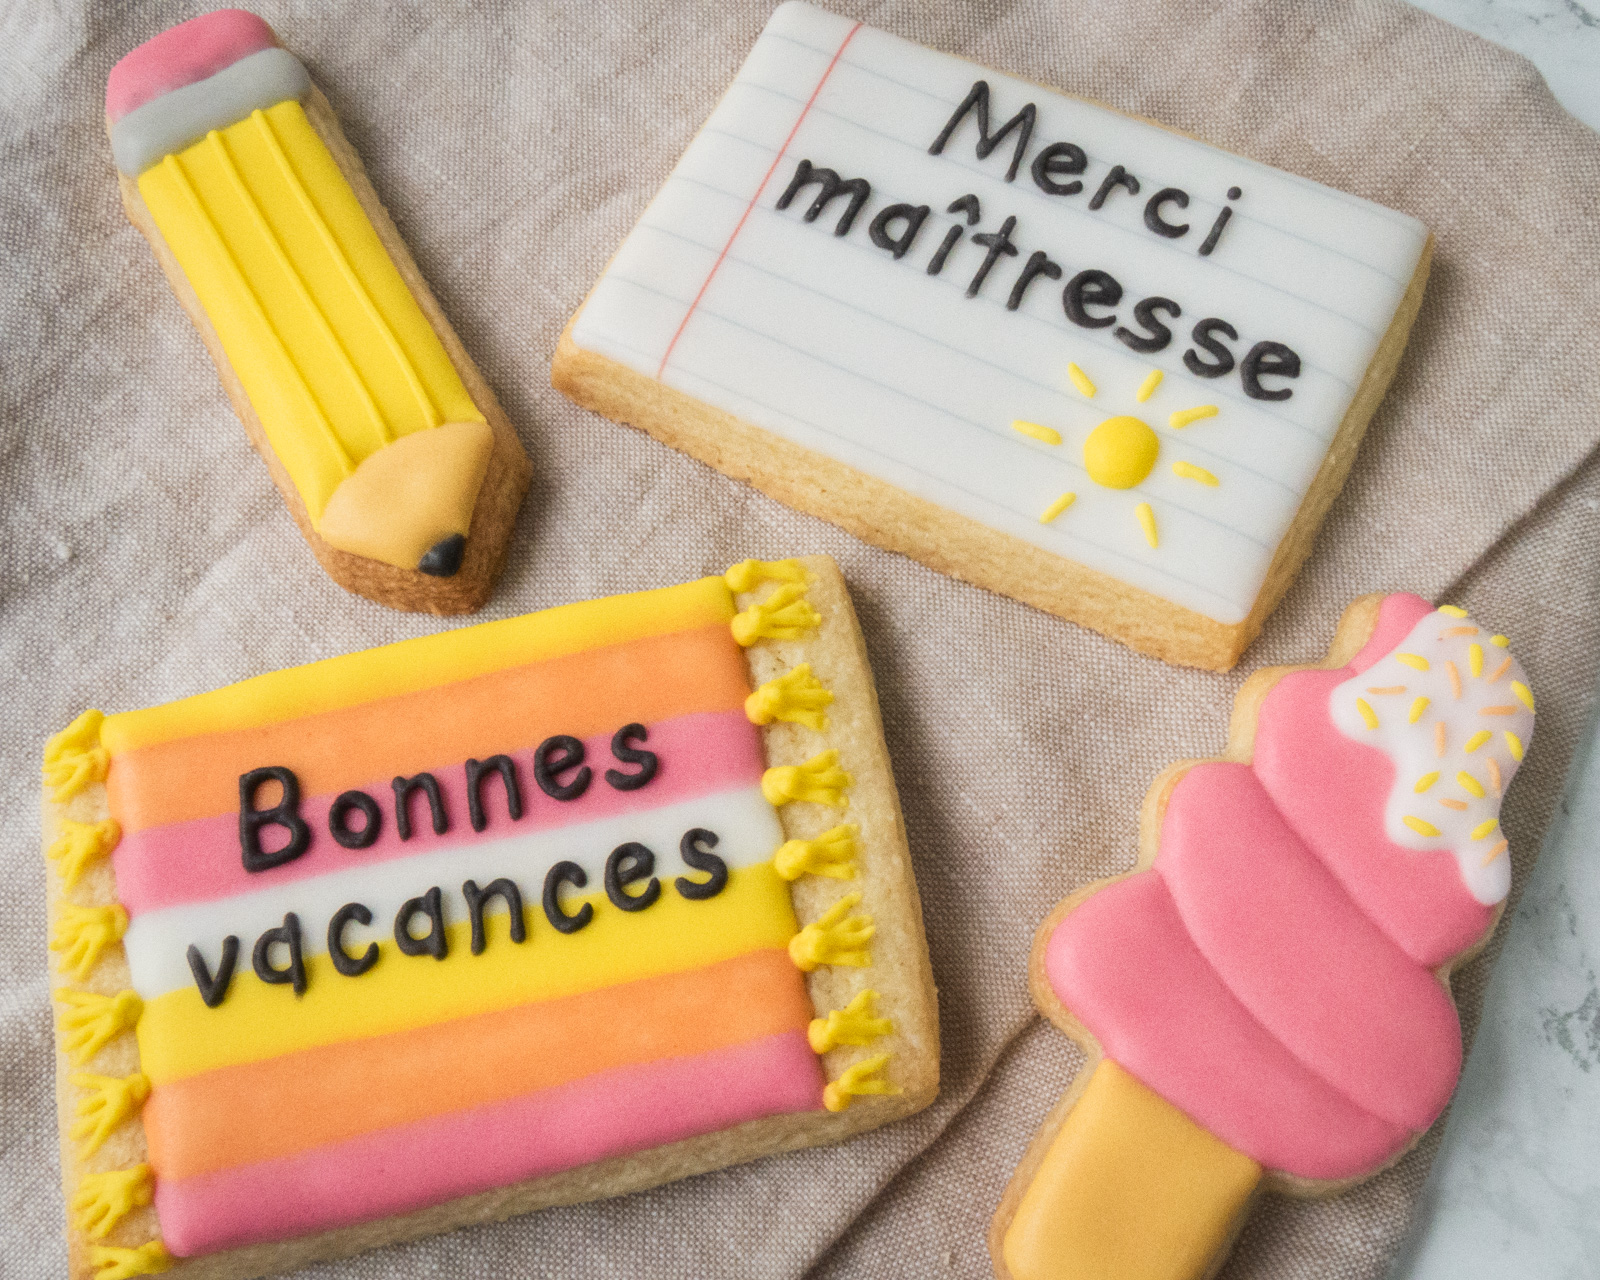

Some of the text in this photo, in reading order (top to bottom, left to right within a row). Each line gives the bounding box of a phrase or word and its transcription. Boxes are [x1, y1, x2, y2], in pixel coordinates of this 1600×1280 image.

[929, 79, 1242, 257] Merci
[775, 158, 1303, 402] maîtresse
[237, 722, 661, 873] Bonnes
[186, 827, 730, 1008] vacances
